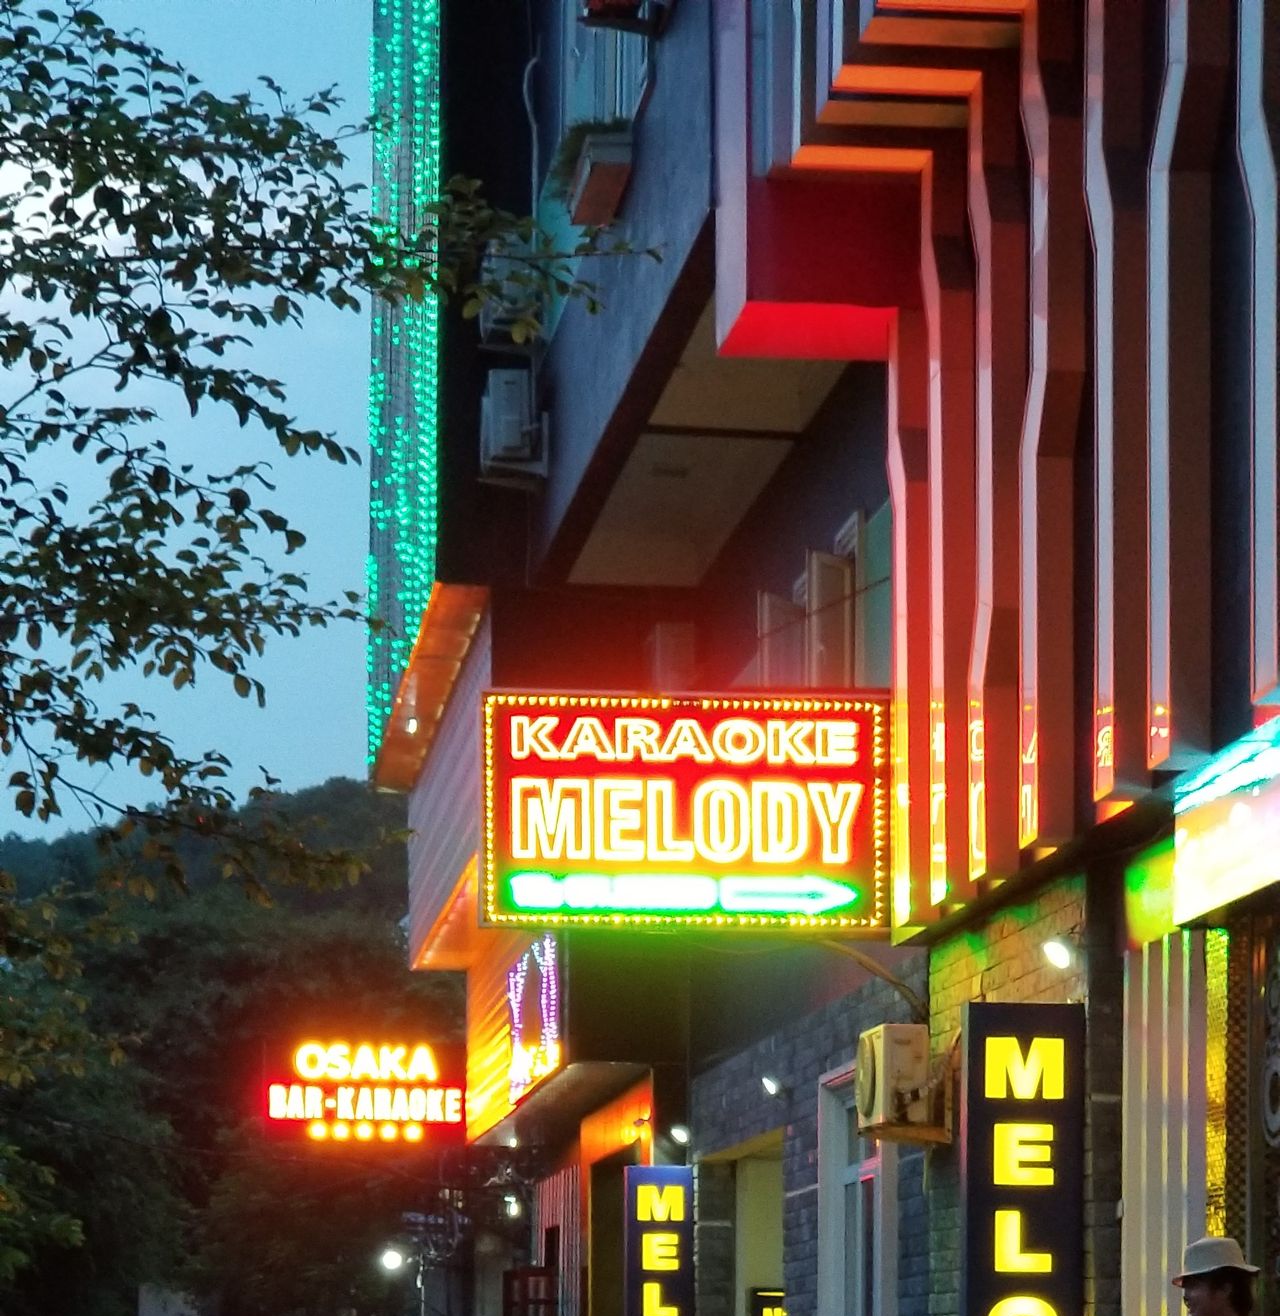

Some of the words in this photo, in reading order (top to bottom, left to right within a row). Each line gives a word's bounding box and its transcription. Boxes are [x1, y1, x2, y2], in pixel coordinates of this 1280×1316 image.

[509, 714, 862, 767] KARAOKE
[510, 776, 863, 865] MELODY
[295, 1042, 439, 1082] OSAKA
